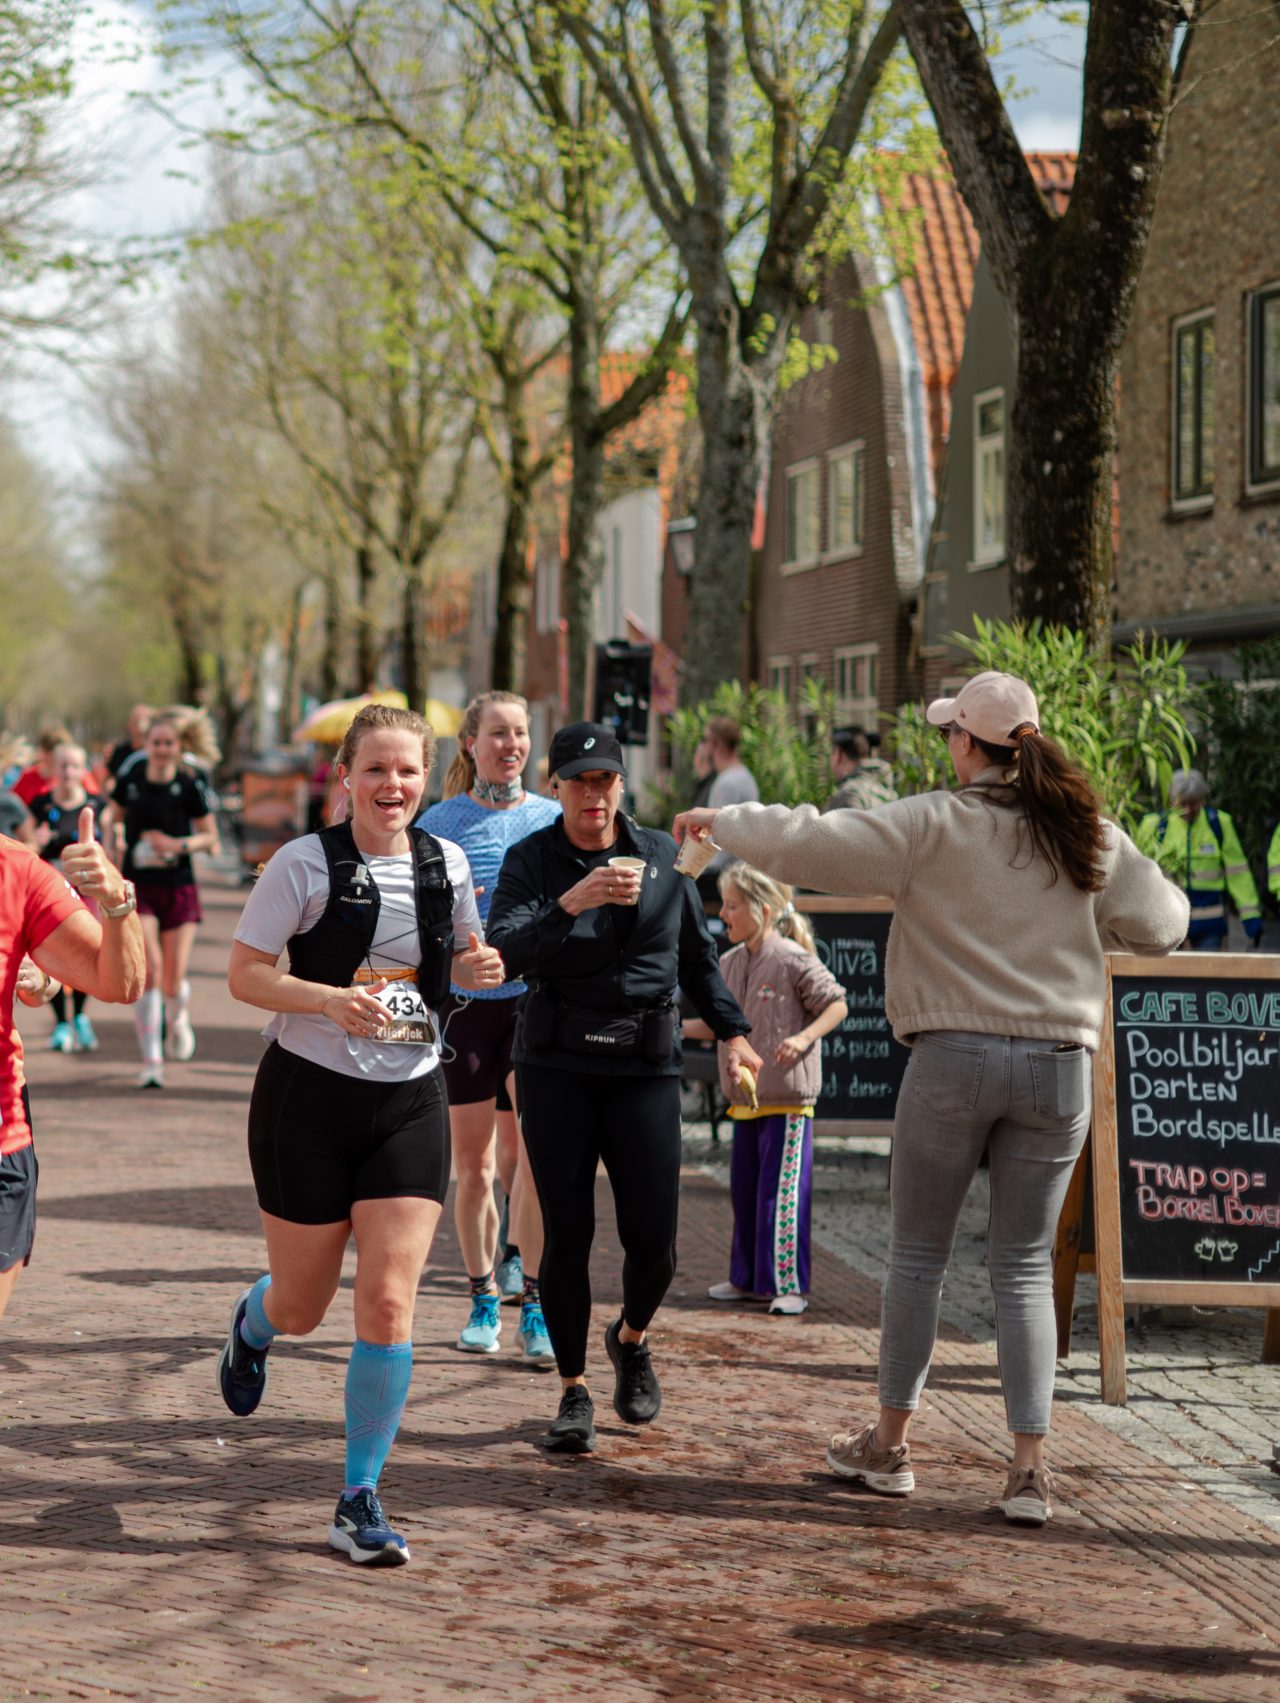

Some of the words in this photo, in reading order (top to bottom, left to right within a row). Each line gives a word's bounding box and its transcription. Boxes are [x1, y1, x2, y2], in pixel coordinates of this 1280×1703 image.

[1120, 991, 1199, 1022] CAFE
[585, 1034, 615, 1044] KIPRUN
[848, 1037, 890, 1063] pizza
[1127, 1030, 1280, 1081] Poolbiljar
[1129, 1159, 1207, 1195] TRAP
